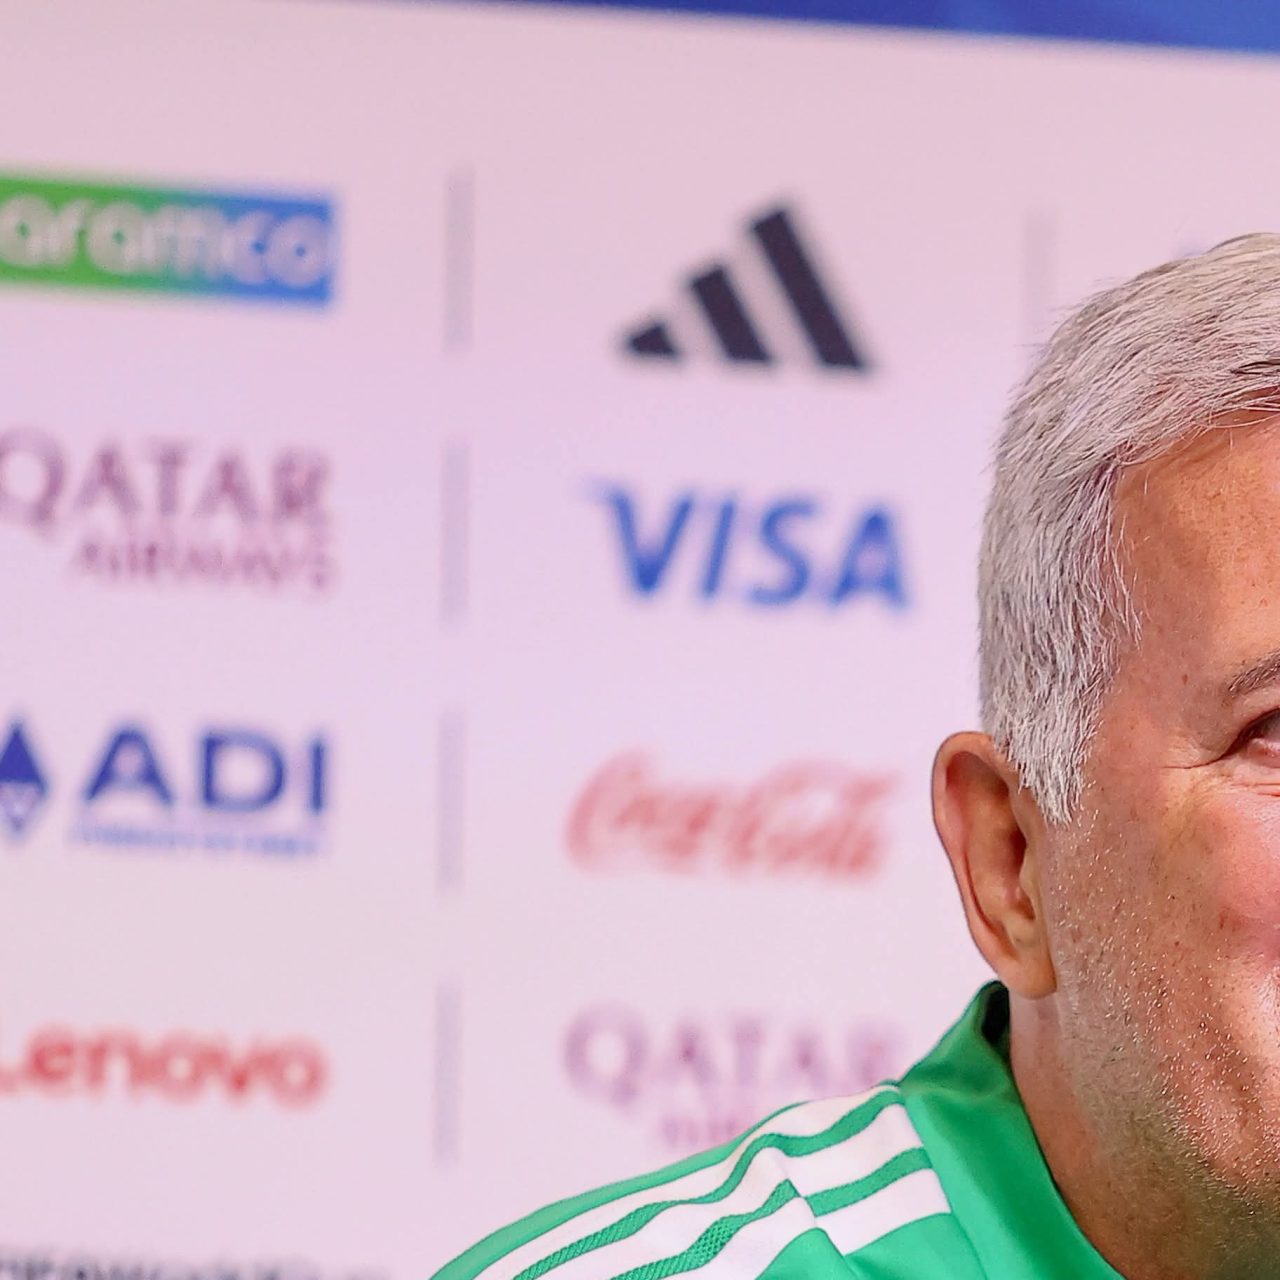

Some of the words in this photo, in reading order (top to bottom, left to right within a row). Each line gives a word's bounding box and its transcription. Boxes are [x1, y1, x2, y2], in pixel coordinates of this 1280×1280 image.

[0, 430, 332, 542] QATAR
[590, 482, 910, 610] VISA
[82, 724, 328, 816] ADI
